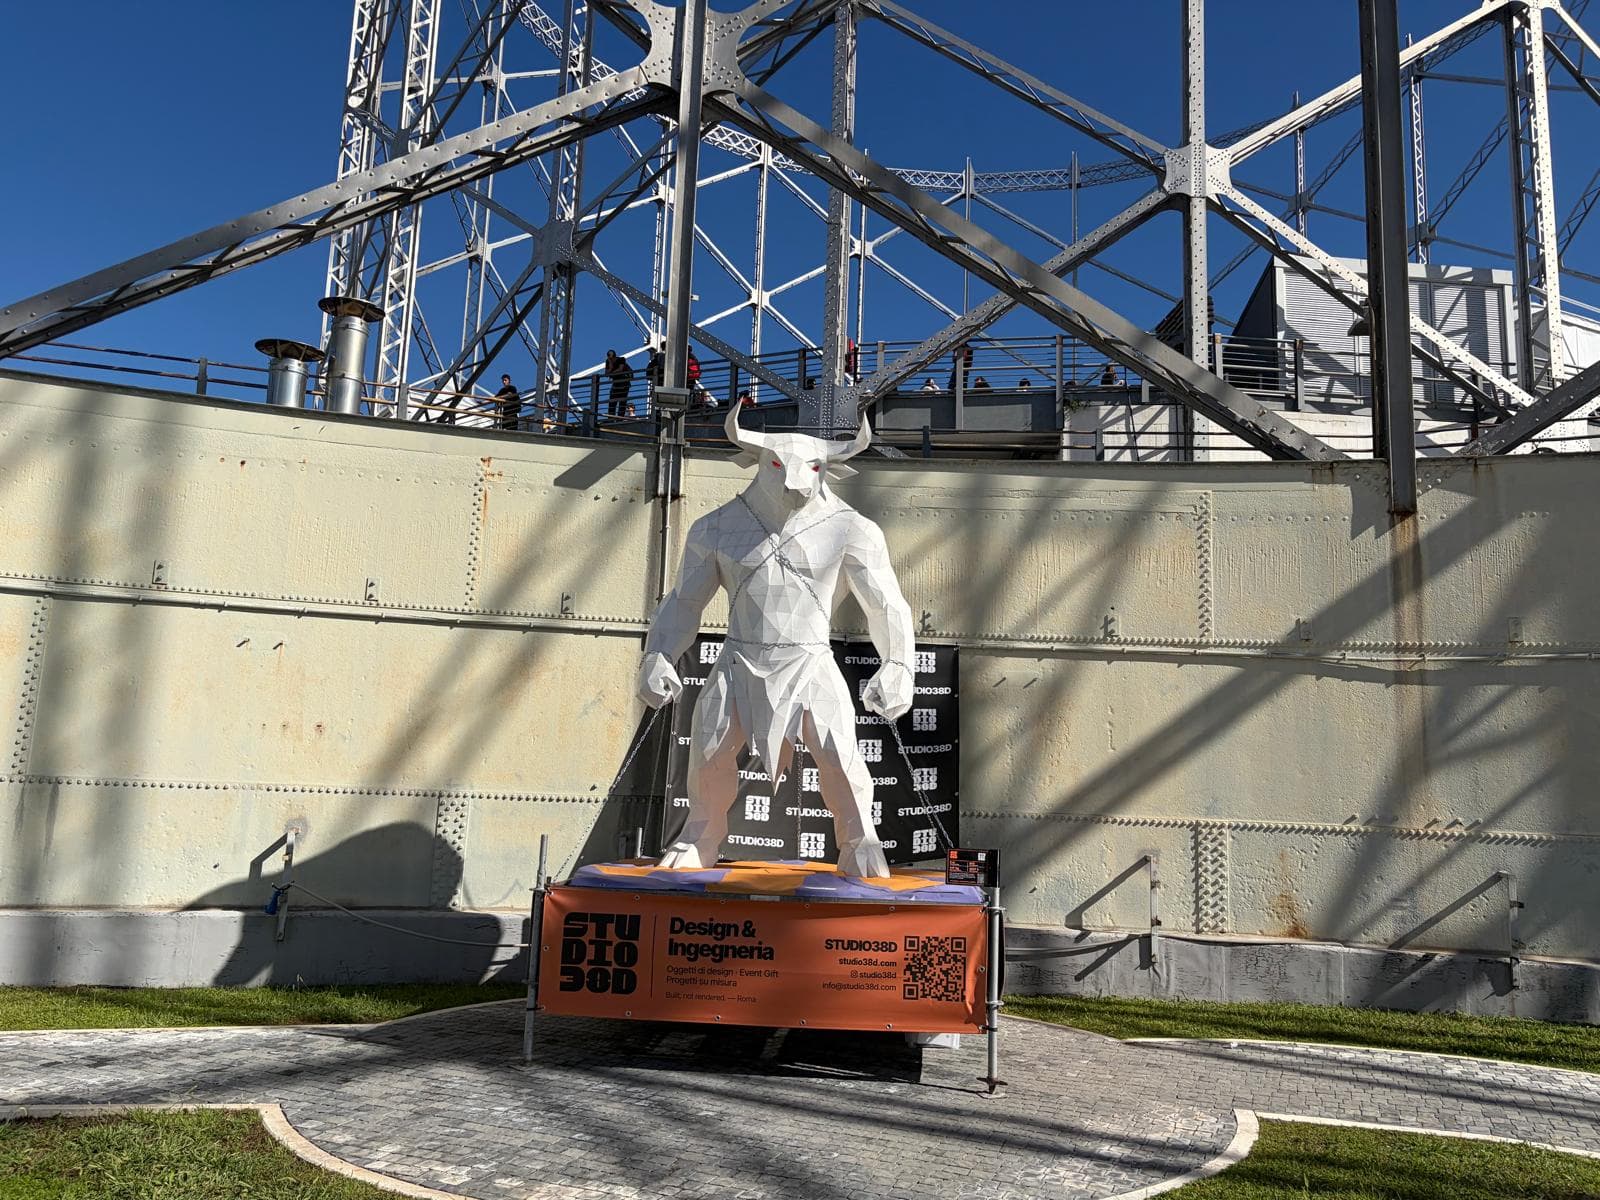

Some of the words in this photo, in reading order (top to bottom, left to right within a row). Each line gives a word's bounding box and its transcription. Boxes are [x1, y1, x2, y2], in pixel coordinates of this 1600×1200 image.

[845, 656, 881, 665] STUDIO
[913, 686, 951, 695] DIO38D
[898, 743, 952, 754] STUDIO38D
[785, 807, 834, 818] STUDIO38
[898, 803, 952, 816] STUDIO38D
[728, 834, 784, 848] STUDIO38D
[563, 912, 641, 941] STU
[670, 917, 739, 941] Design
[741, 920, 756, 938] &
[668, 938, 774, 963] Ingegneria
[825, 939, 898, 952] STUDIO38D
[561, 938, 639, 968] DIO
[838, 957, 897, 967] studio38d.com
[666, 965, 696, 975] Oggetti
[697, 967, 706, 975] di
[706, 968, 734, 977] design
[739, 968, 762, 977] Event
[763, 969, 779, 978] Gift
[859, 971, 897, 979] studio38d
[666, 975, 698, 986] Progetti
[710, 978, 738, 987] misura
[822, 982, 897, 991] info@studio38d.com
